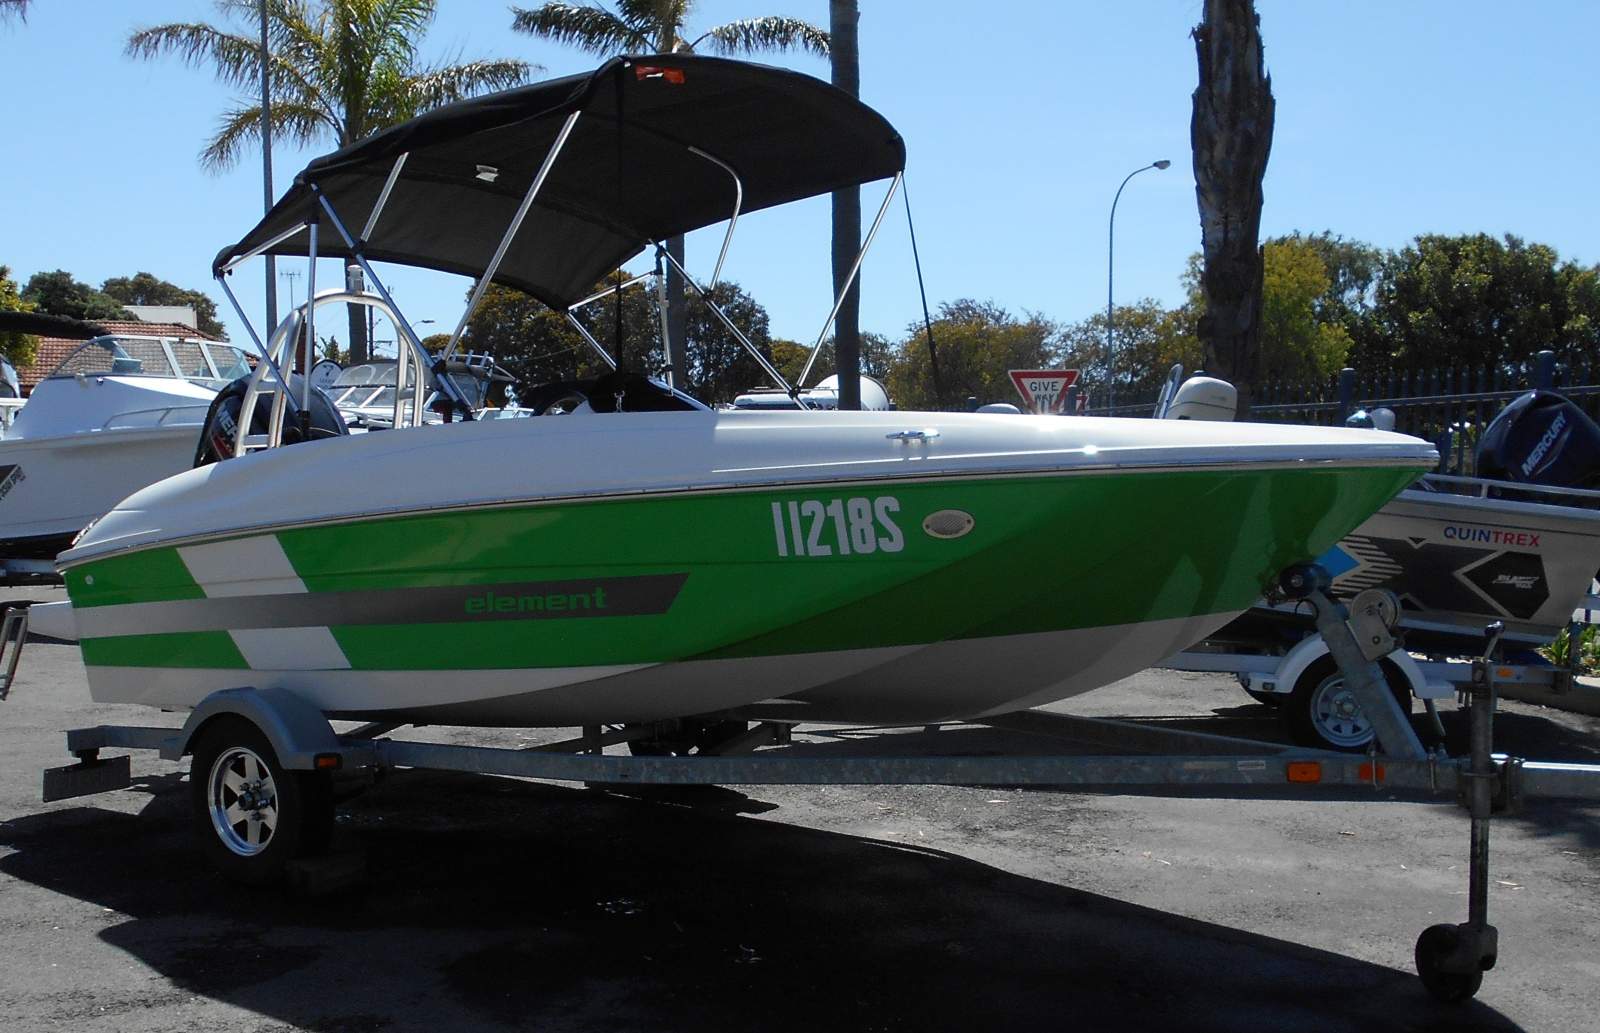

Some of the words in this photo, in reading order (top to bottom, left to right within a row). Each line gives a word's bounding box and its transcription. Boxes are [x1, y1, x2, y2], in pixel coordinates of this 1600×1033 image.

[1030, 381, 1059, 392] GIVE
[1521, 410, 1566, 476] MERCURY
[1443, 526, 1540, 547] QUINTREX
[465, 586, 606, 613] element
